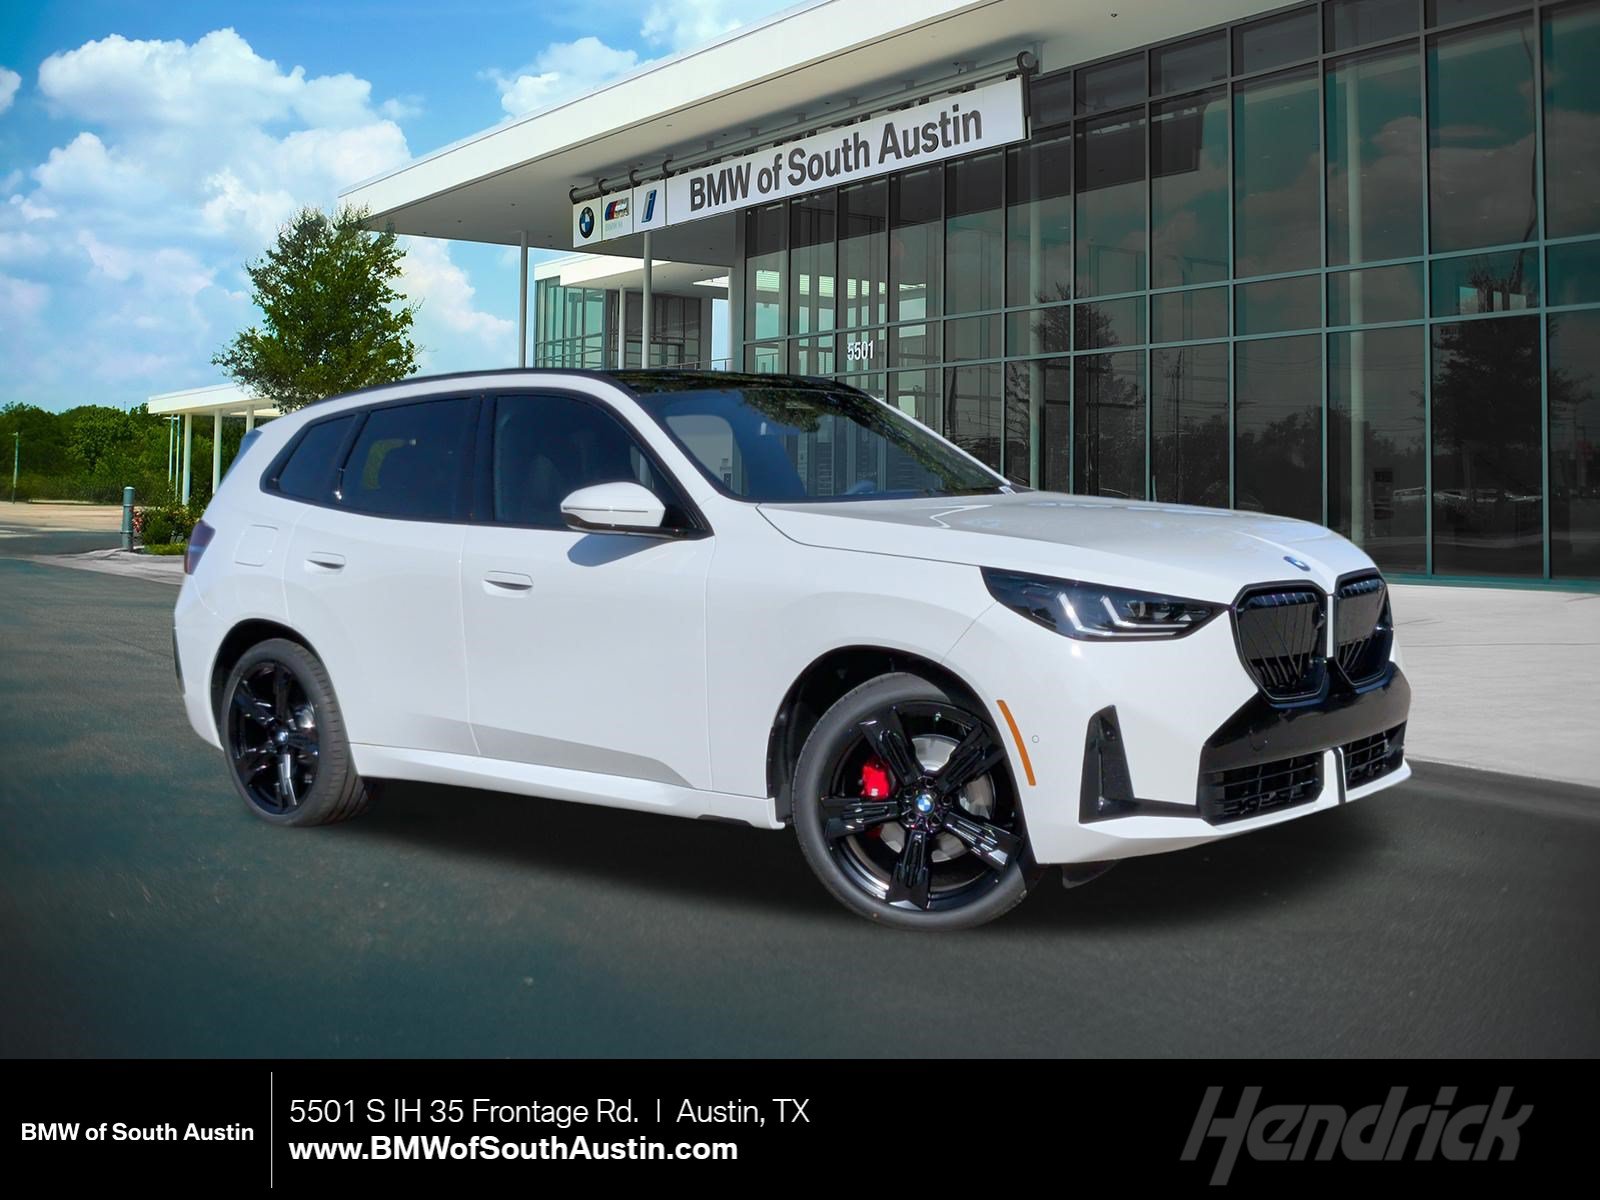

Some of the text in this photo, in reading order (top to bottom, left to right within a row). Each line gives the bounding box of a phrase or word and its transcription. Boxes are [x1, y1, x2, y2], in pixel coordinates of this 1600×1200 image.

[689, 162, 751, 212] BMW
[757, 153, 783, 194] of
[787, 132, 870, 186] South
[878, 103, 983, 164] Austin
[847, 340, 874, 361] 5501
